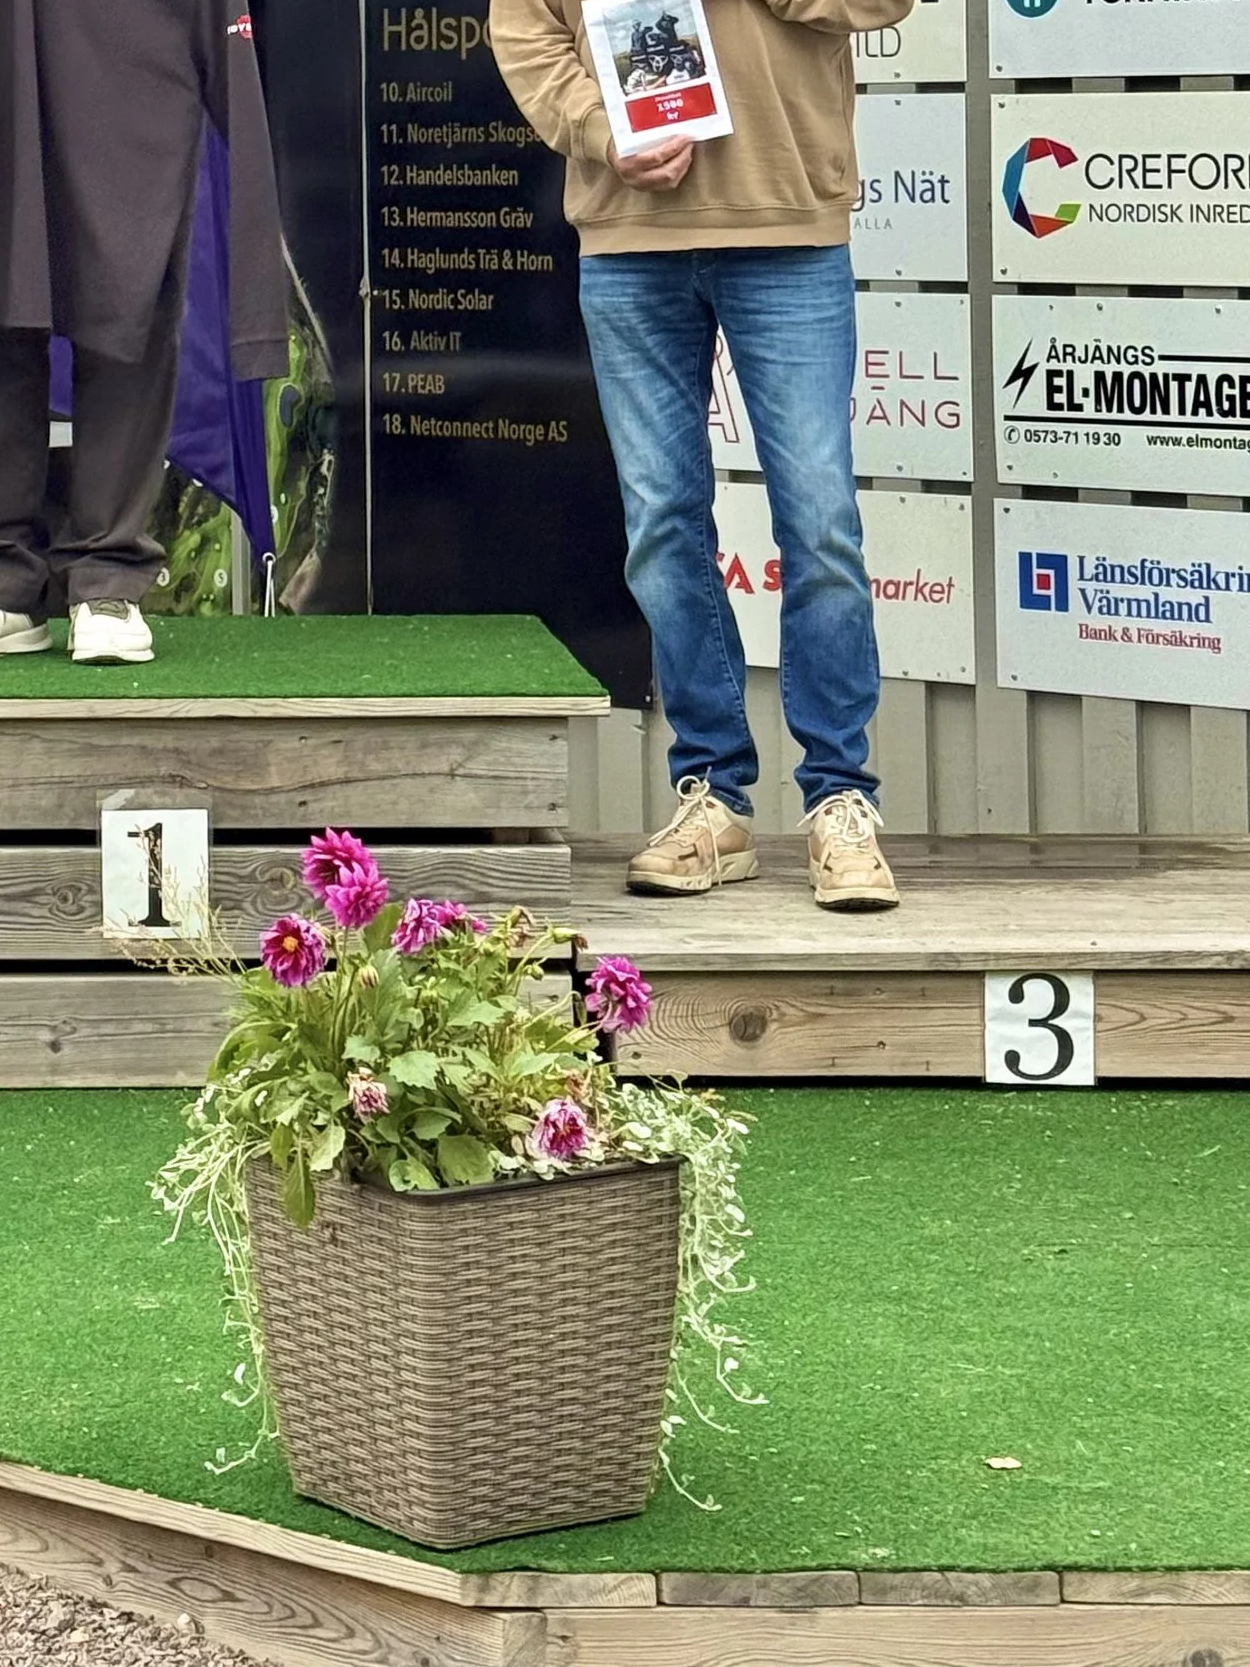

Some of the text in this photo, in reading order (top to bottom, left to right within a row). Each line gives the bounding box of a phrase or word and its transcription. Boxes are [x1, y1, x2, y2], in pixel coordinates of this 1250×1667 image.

[380, 81, 453, 103] 10. Aircoil
[380, 123, 403, 144] 11.
[406, 122, 485, 149] Noretjärns
[380, 164, 519, 186] 12. Handelsbanken
[1084, 153, 1250, 191] CREFOR
[893, 170, 951, 205] Nät
[380, 206, 404, 227] 13.
[406, 206, 497, 228] Hermansson
[1088, 203, 1184, 223] NORDISK
[382, 247, 554, 274] 14. Haglunds Trä & Horn
[382, 288, 494, 311] 15. Nordic Solar
[382, 330, 462, 352] 16. Aktiv IT
[1046, 337, 1156, 366] ÅRJÄNGS
[382, 372, 445, 395] 17. PEAB
[382, 413, 568, 446] 18. Netconnect Norge AS
[1078, 587, 1213, 625] Värmland
[1078, 623, 1221, 654] Bank & Försäkring
[127, 821, 181, 927] 1
[1004, 972, 1075, 1082] 3
